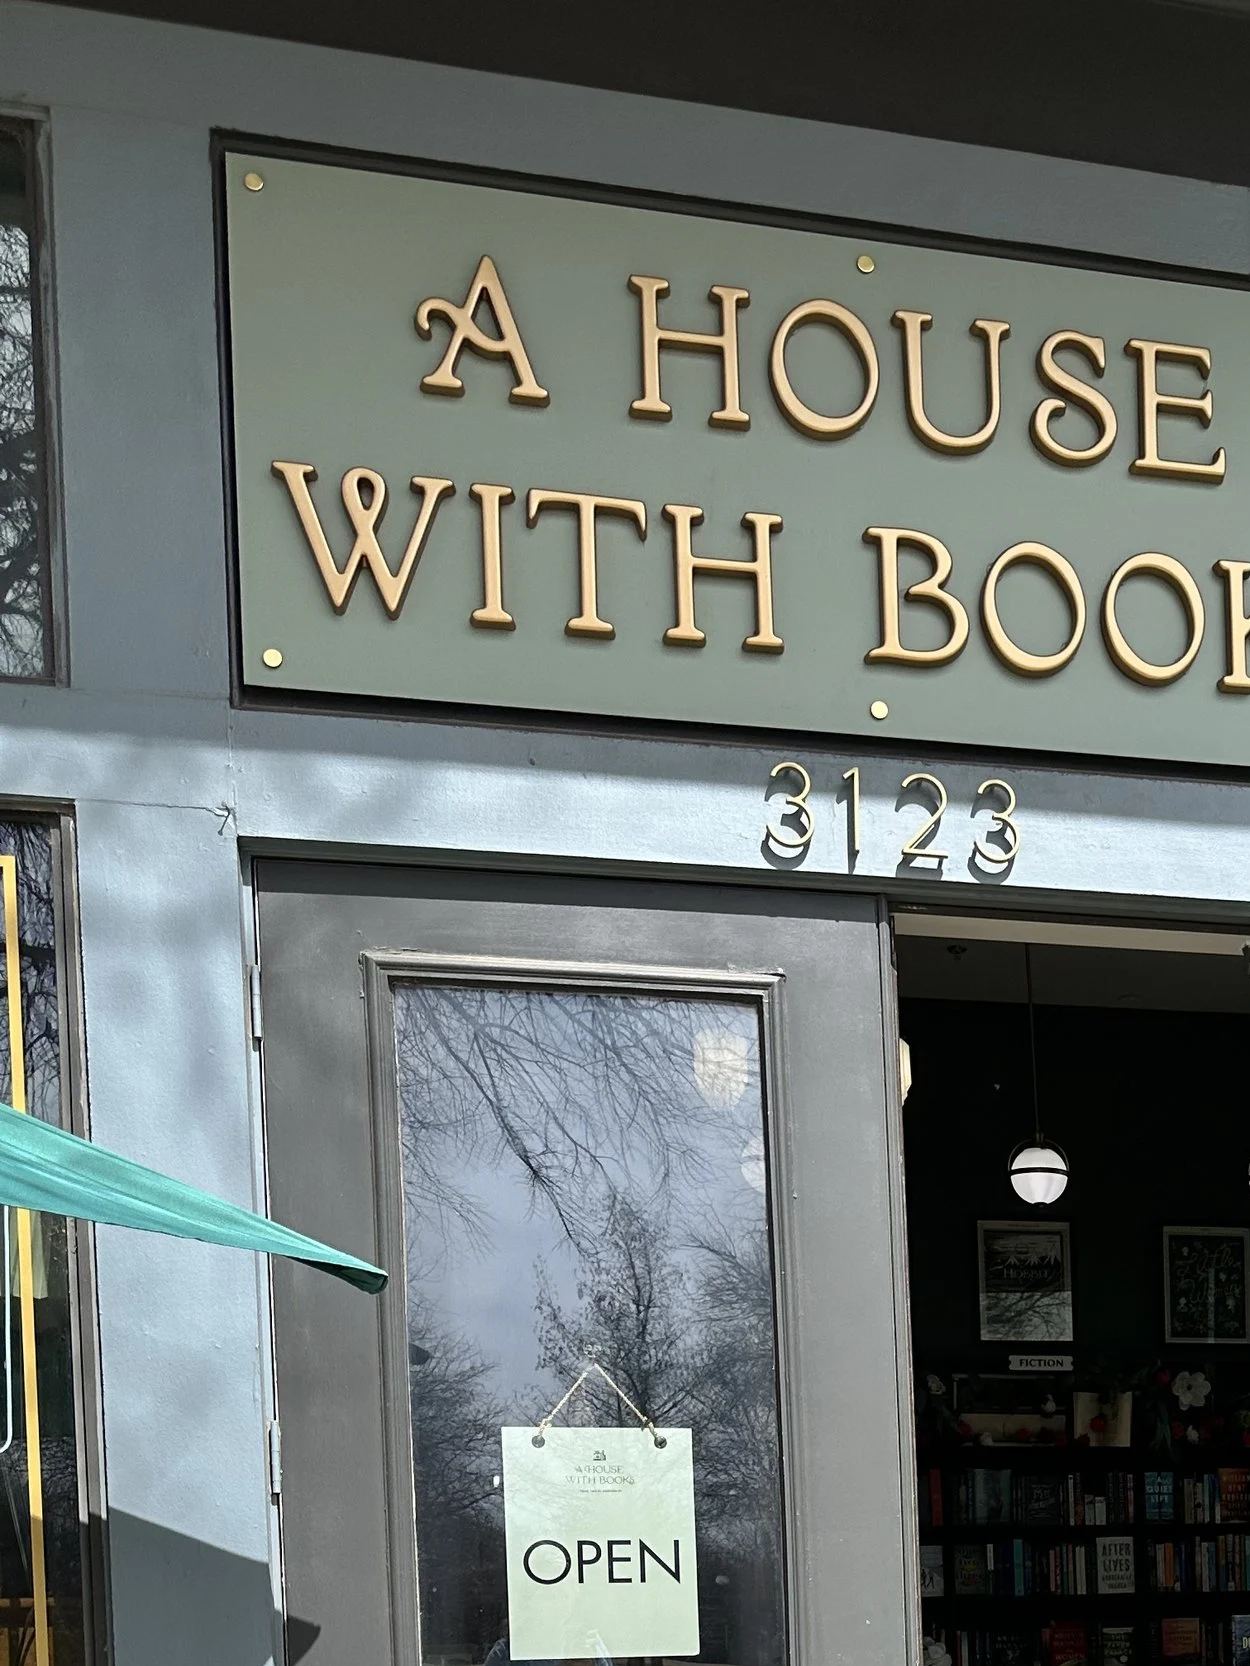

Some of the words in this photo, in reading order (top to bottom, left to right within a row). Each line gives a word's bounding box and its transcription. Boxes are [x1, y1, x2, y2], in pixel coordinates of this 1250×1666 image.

[415, 254, 550, 405] A
[629, 273, 1227, 485] HOUSE
[270, 460, 785, 654] WITH
[766, 761, 1021, 864] 3123
[1019, 1358, 1065, 1368] FICTION
[584, 1465, 625, 1474] HOUSE
[566, 1475, 596, 1484] WITH
[599, 1474, 635, 1485] BOOKS
[1102, 1543, 1130, 1556] AFTER
[522, 1539, 681, 1585] OPEN
[1103, 1559, 1130, 1572] LIVES
